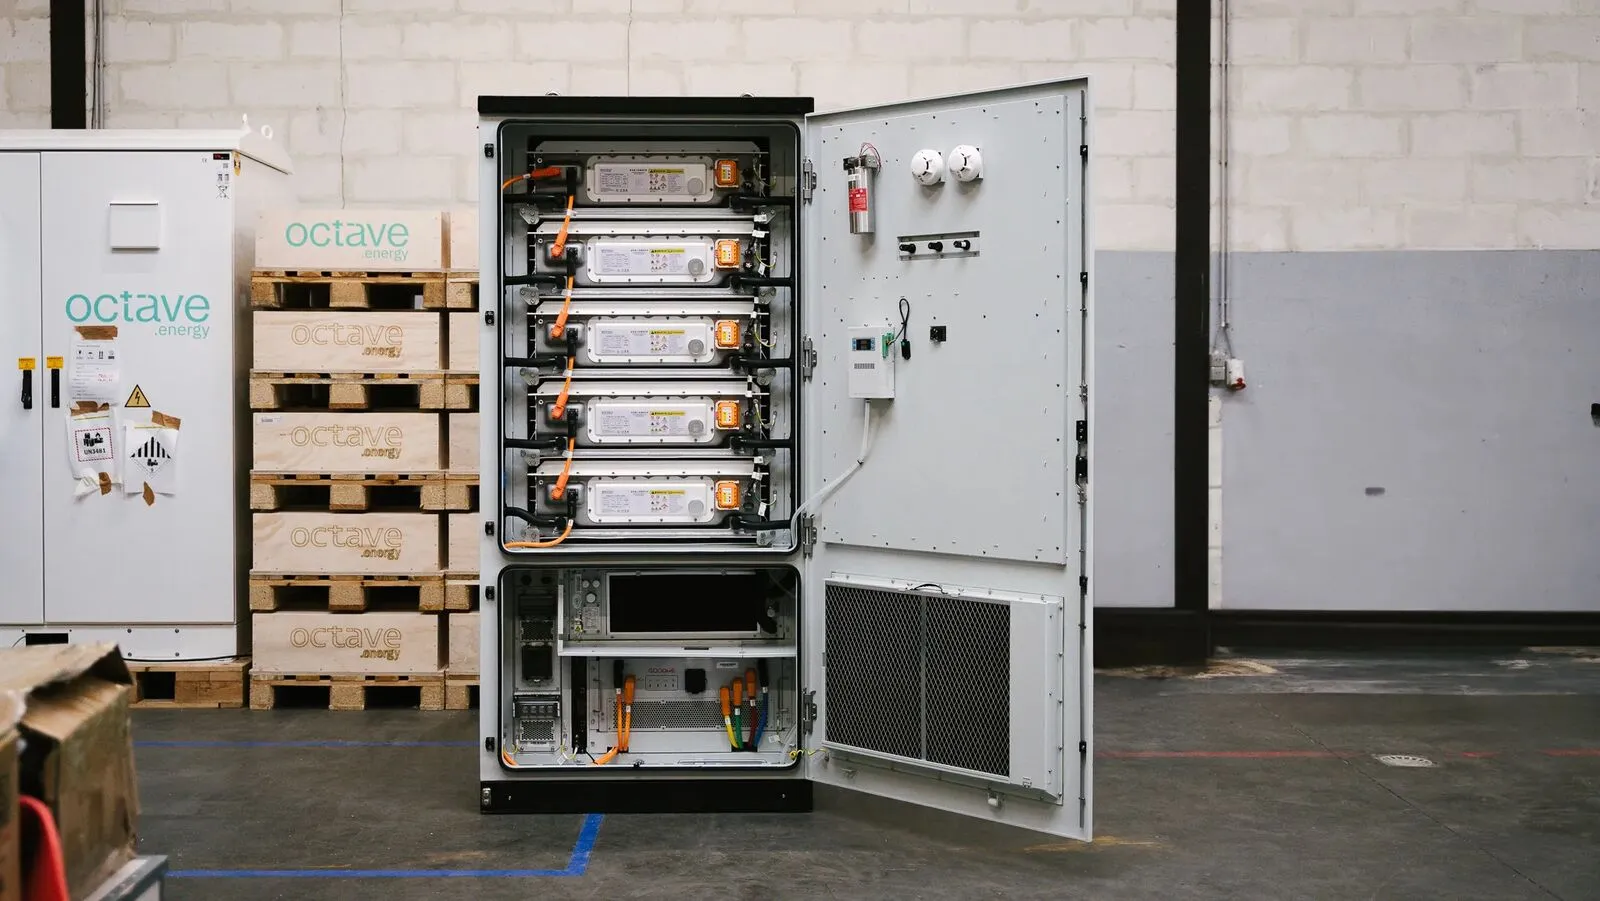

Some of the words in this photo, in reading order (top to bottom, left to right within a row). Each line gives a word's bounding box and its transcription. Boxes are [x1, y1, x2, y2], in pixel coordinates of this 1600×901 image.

[285, 220, 409, 247] octave
[363, 248, 409, 261] .energy
[65, 291, 210, 323] octave
[154, 323, 210, 340] .energy
[290, 323, 404, 346] octave
[290, 424, 403, 447] octave
[83, 447, 107, 455] UN3481
[290, 525, 403, 548] octave
[289, 626, 402, 649] octave
